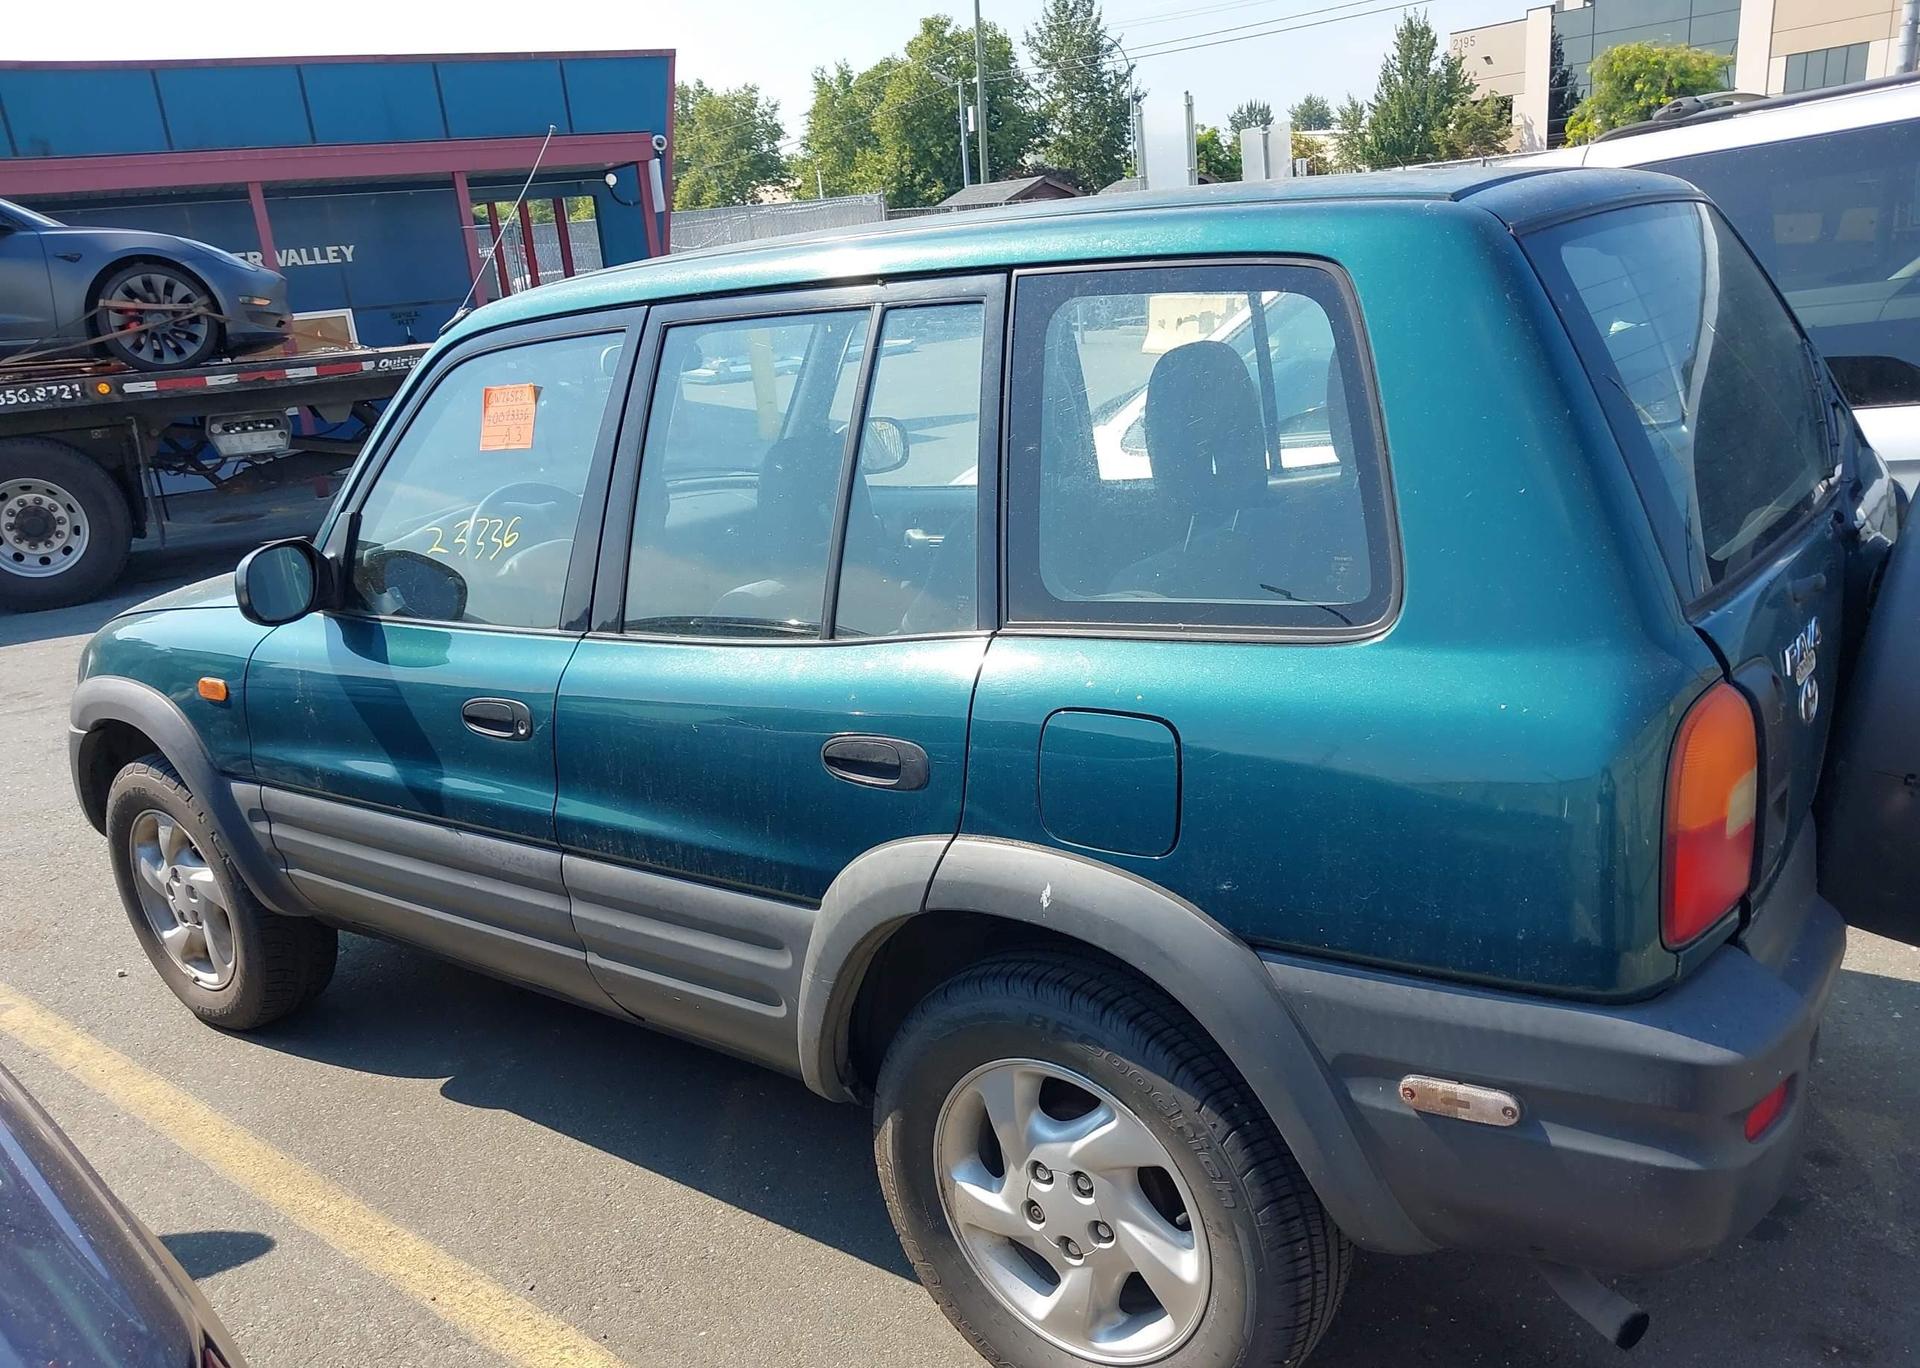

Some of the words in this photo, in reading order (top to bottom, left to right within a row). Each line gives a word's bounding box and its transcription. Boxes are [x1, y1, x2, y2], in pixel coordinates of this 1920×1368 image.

[1453, 35, 1476, 50] 2195
[274, 245, 355, 267] VALLEY
[425, 516, 522, 561] 23336
